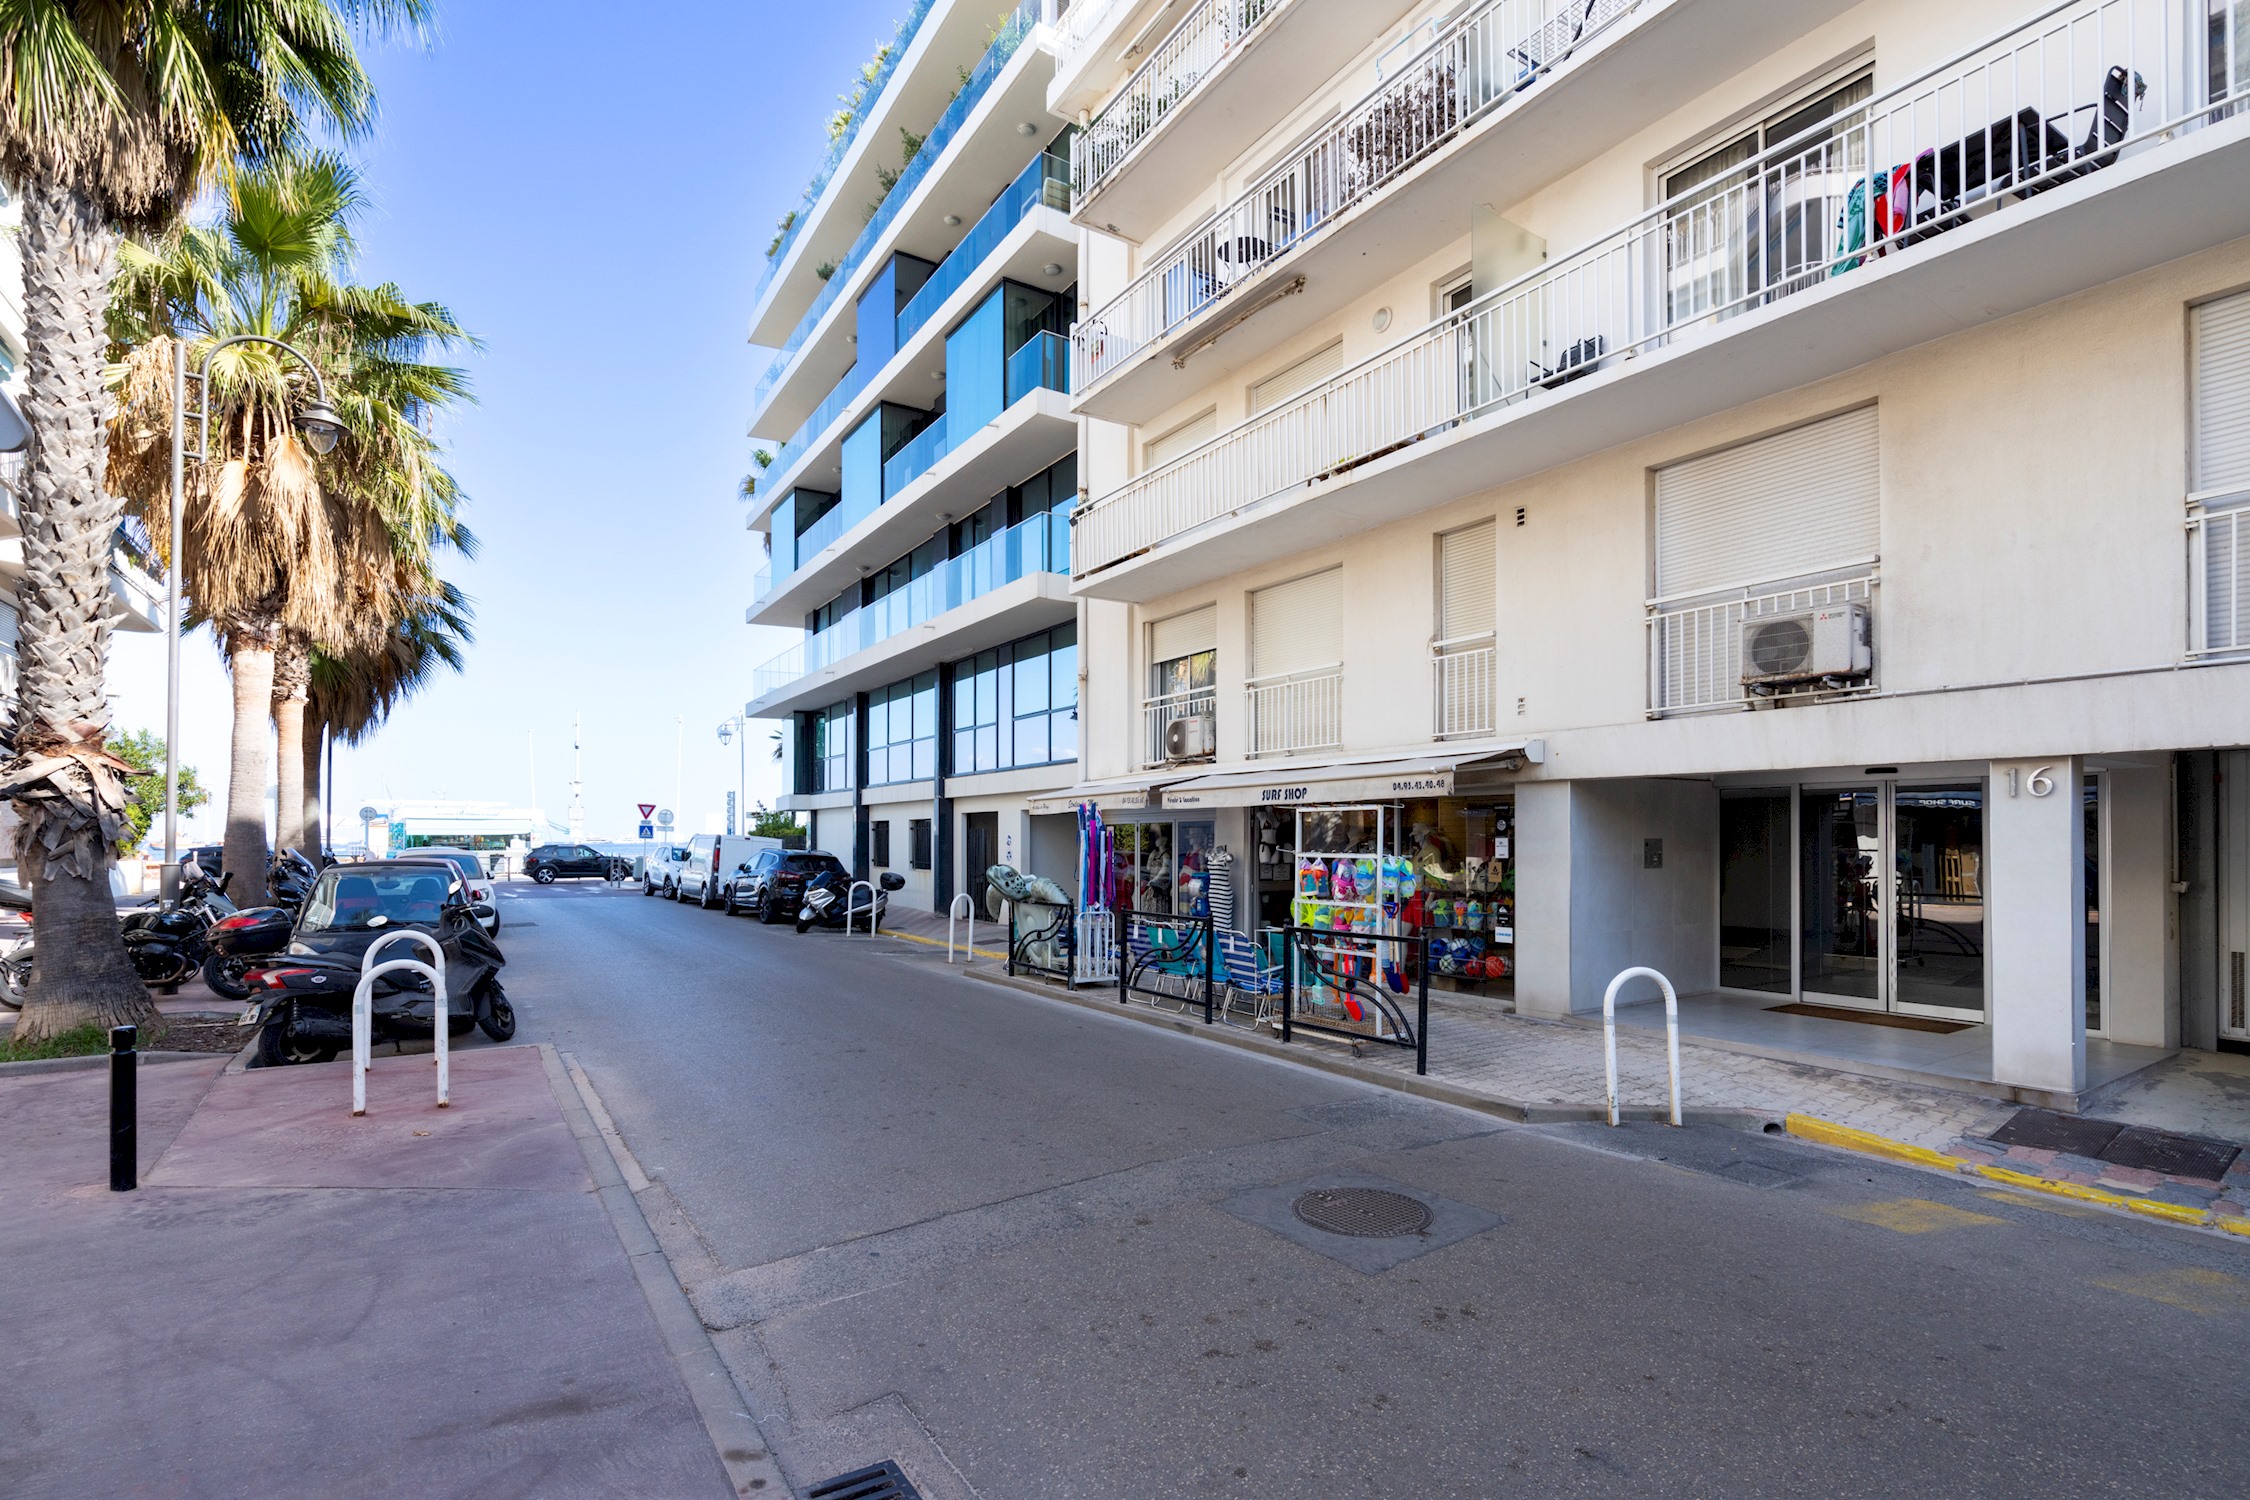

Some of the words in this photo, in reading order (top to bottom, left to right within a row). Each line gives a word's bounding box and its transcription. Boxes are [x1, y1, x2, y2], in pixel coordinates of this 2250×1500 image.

[2004, 765, 2053, 798] 16
[1262, 789, 1282, 801] SURF
[1284, 787, 1307, 801] SHOP
